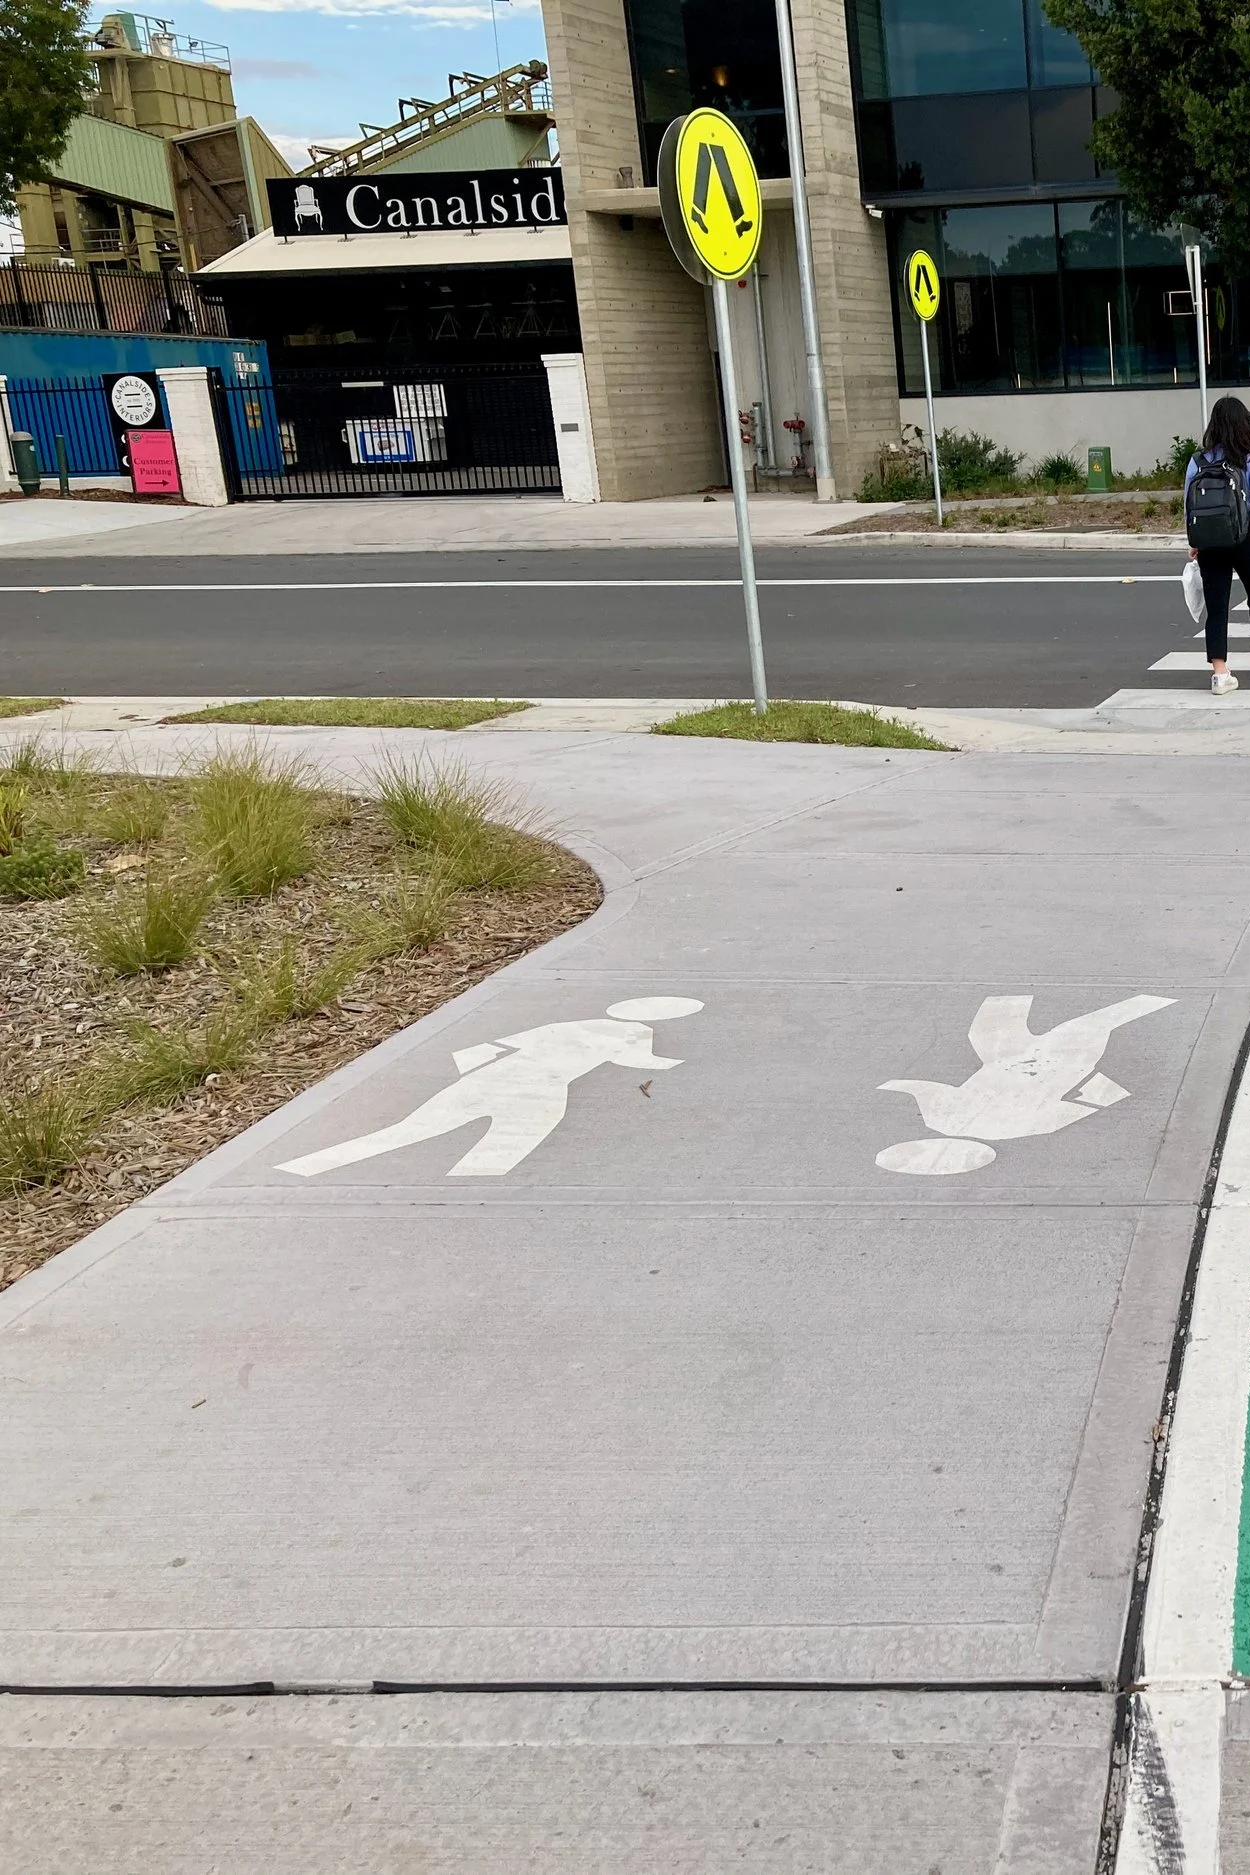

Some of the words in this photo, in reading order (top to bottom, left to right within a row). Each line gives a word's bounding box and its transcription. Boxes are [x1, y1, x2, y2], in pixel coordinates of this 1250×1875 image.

[346, 176, 569, 229] Canalsid
[115, 380, 151, 399] CANALSIDE
[117, 402, 153, 421] INTERIORS
[140, 468, 172, 476] Parking
